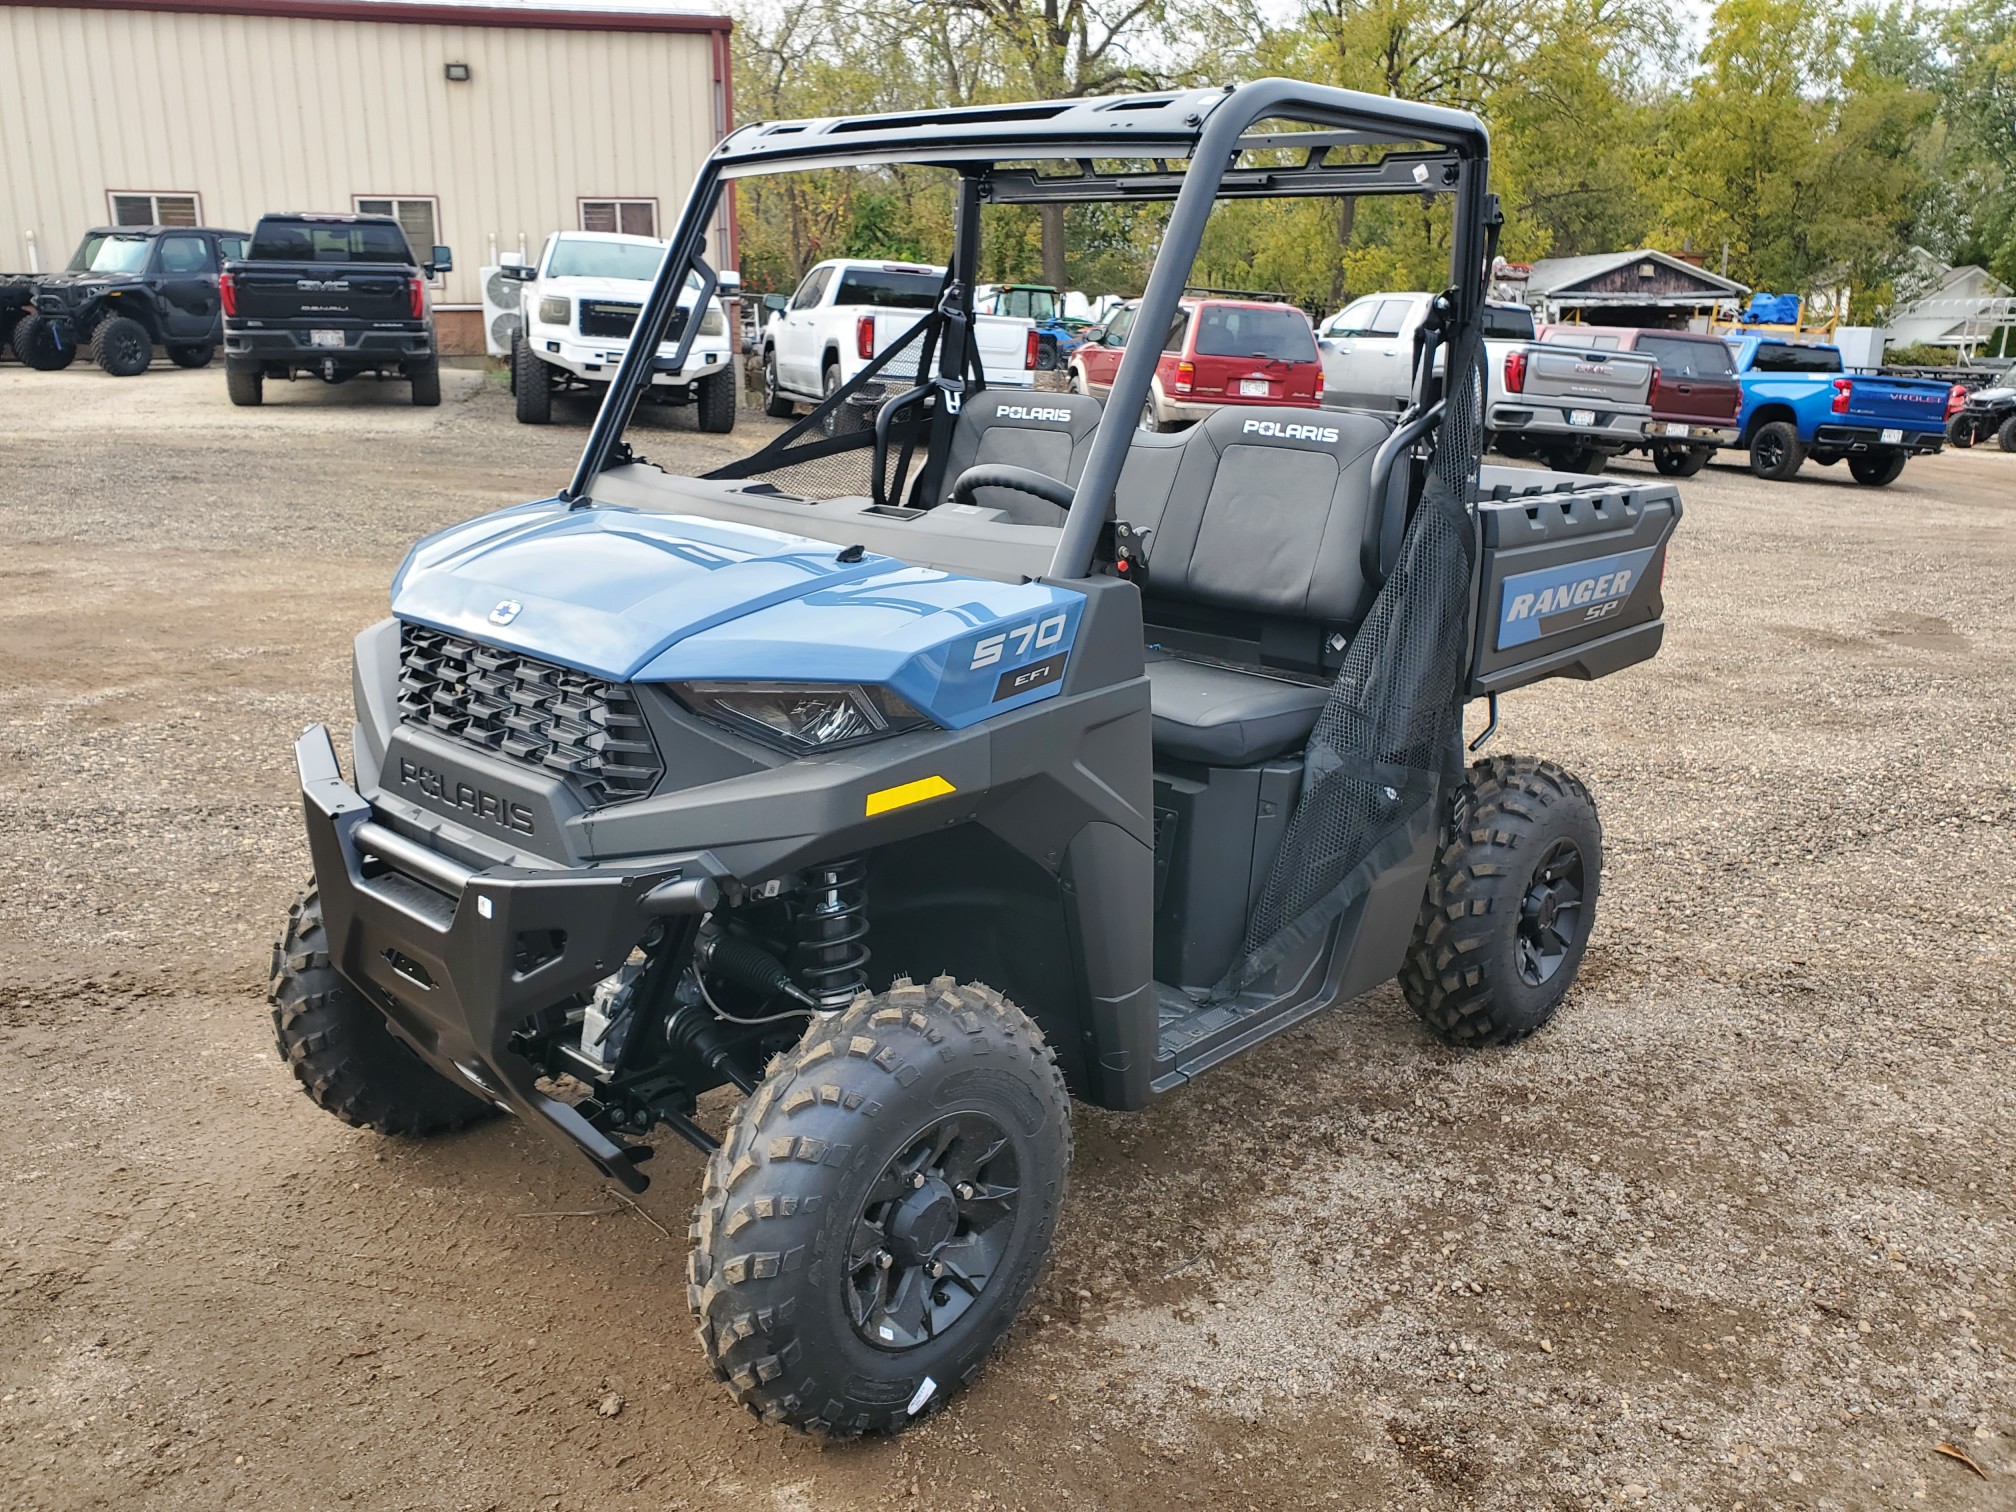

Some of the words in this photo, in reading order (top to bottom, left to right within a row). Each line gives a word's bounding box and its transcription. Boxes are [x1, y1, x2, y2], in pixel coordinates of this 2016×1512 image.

[296, 279, 350, 291] GMC
[996, 405, 1072, 422] POLARIS
[1242, 419, 1339, 443] POLARIS
[1506, 569, 1632, 622] RANGER
[1583, 600, 1619, 621] SP
[969, 613, 1067, 671] 570
[1014, 666, 1050, 687] EFI
[400, 757, 535, 837] POLARIS
